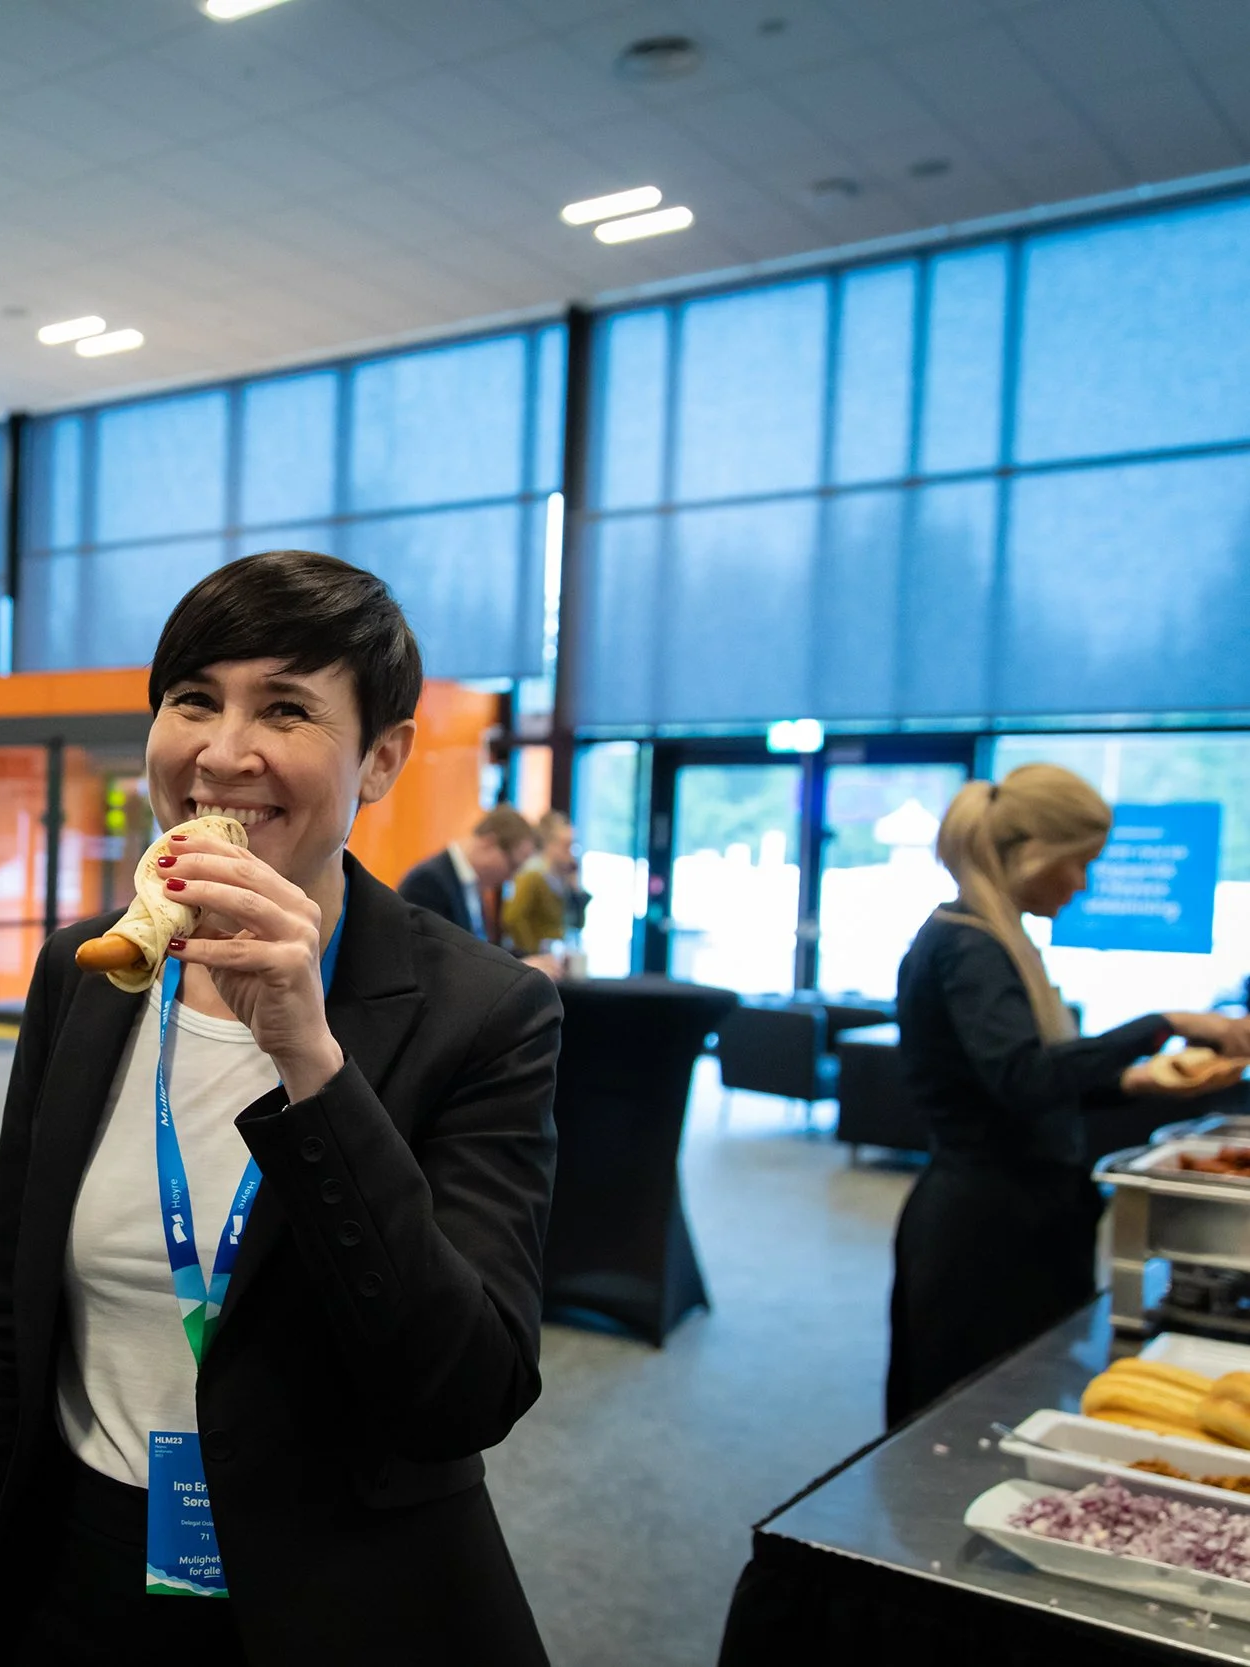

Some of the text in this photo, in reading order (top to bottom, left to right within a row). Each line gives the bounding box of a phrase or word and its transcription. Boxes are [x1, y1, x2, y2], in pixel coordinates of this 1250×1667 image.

[170, 1178, 182, 1209] Høyre
[238, 1181, 256, 1210] Høyre
[155, 1436, 183, 1445] HLM23
[174, 1481, 208, 1492] Ine Er
[200, 1533, 210, 1541] 71
[179, 1555, 221, 1567] Mulighet
[190, 1566, 221, 1576] for alle
